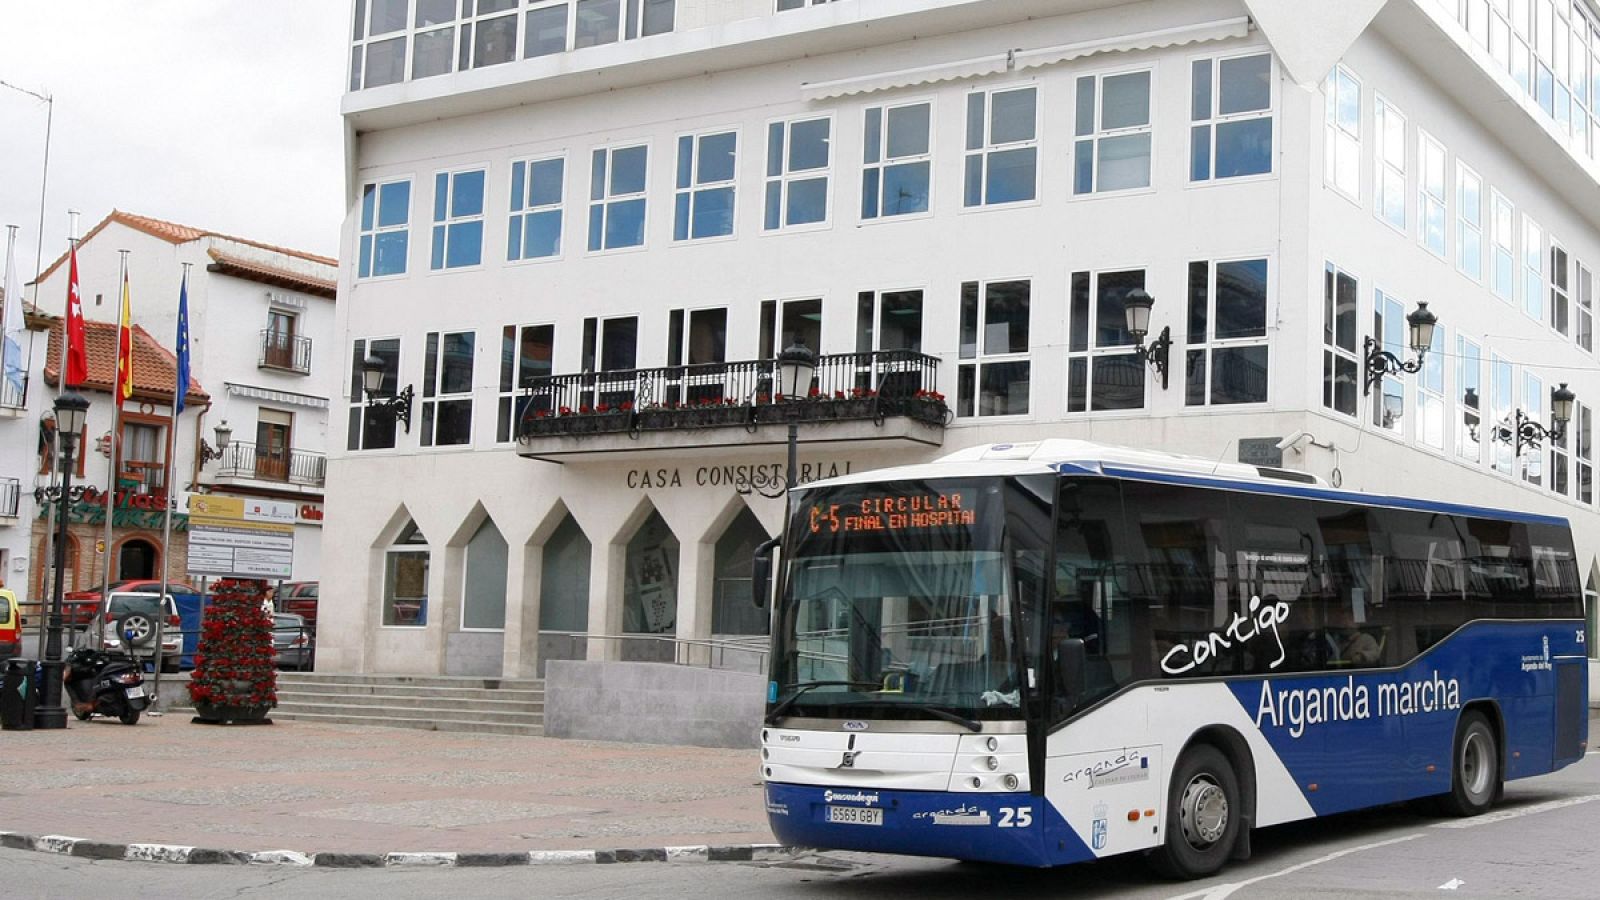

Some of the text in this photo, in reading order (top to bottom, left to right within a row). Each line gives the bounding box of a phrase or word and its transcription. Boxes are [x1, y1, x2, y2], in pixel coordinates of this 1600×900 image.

[627, 461, 852, 489] CASA CONSISTRIA
[861, 494, 962, 514] CIRCULAR
[810, 504, 840, 533] C-5
[844, 515, 885, 531] FINAL
[889, 514, 907, 529] EN
[1161, 596, 1289, 674] contigo
[1575, 630, 1585, 643] 25
[1256, 670, 1460, 738] Arganda marcha
[1063, 747, 1139, 790] arganda
[833, 808, 879, 823] 6569 GBY
[912, 803, 1033, 828] arganda 25
